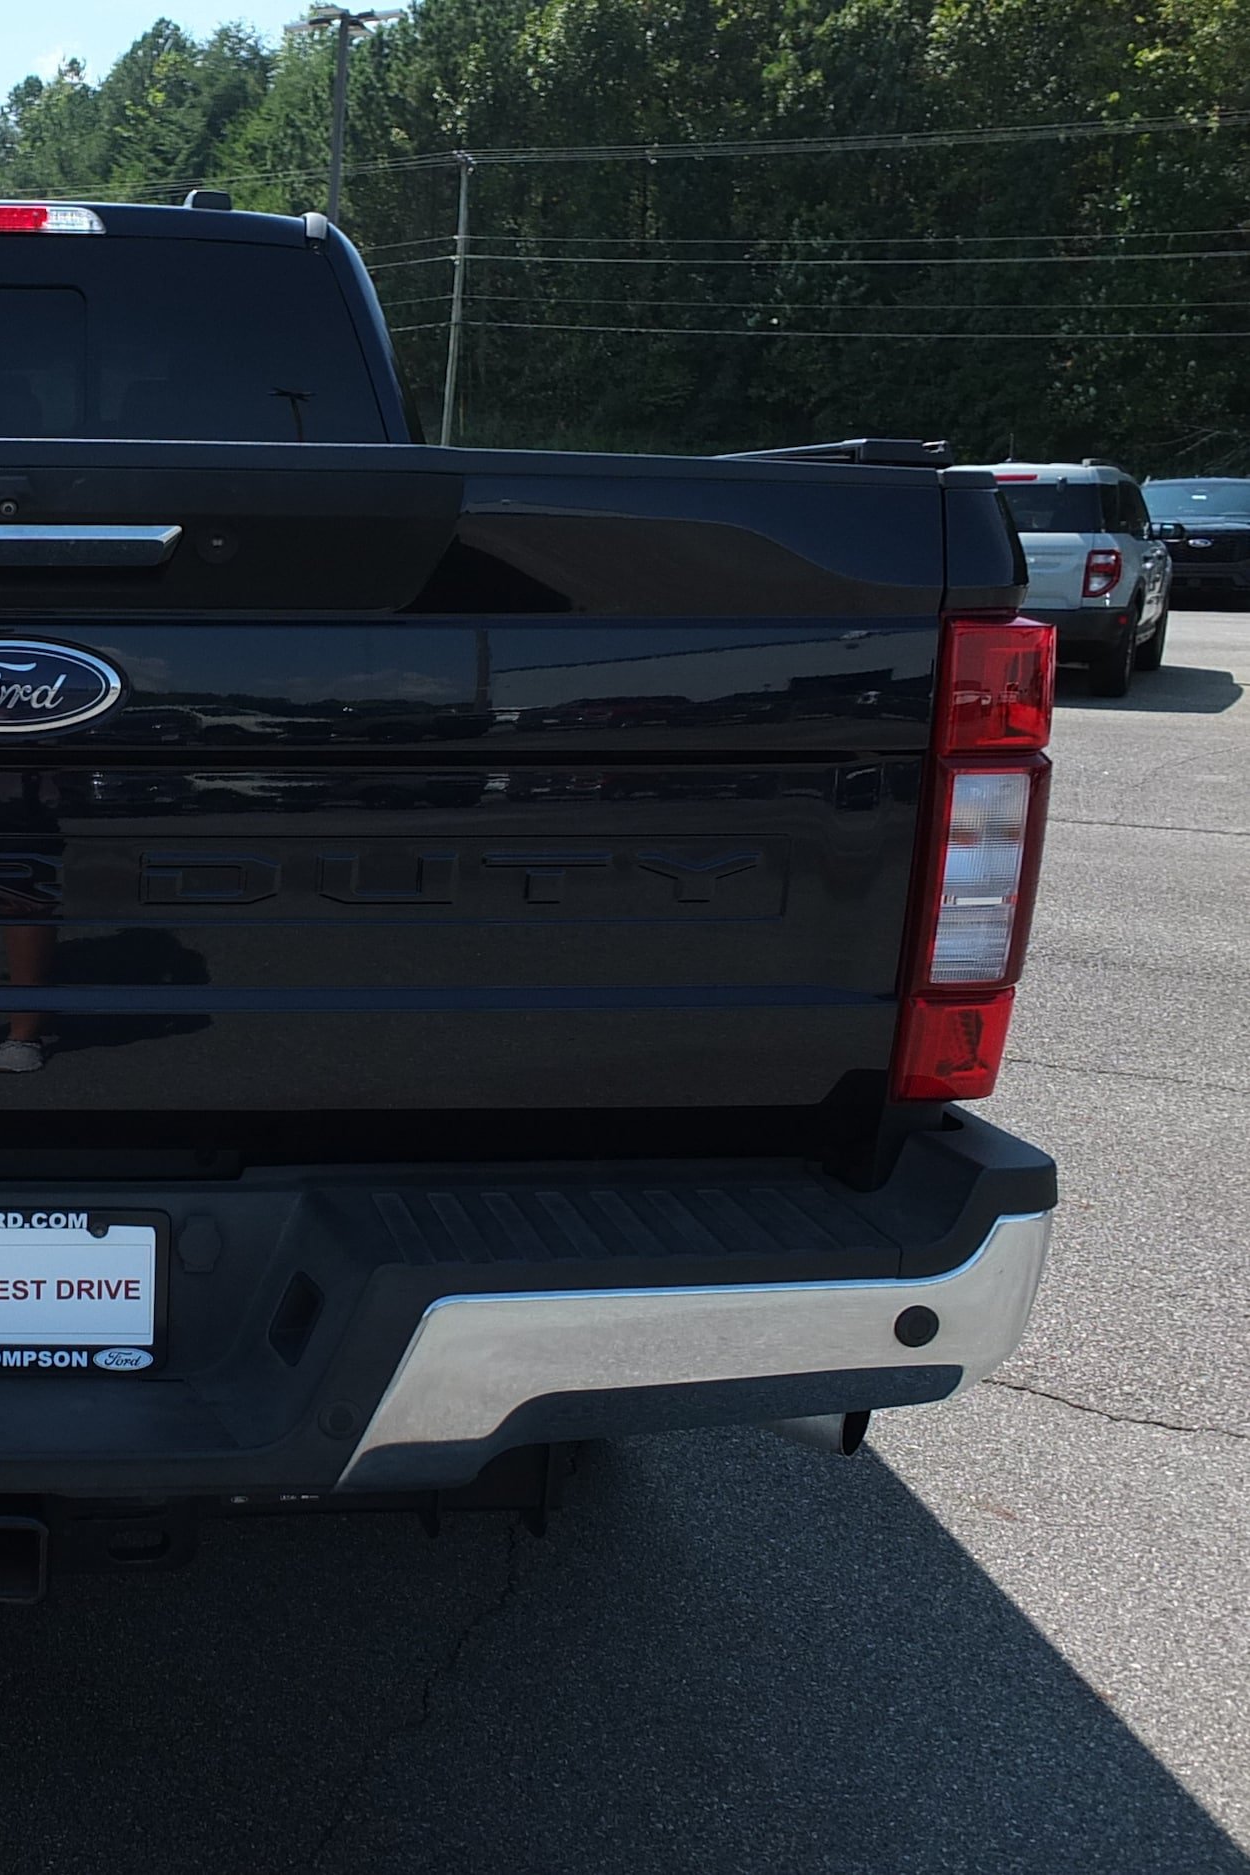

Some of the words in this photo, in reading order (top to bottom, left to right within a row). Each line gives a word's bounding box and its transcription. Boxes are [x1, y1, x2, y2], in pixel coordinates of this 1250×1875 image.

[140, 848, 765, 908] DUTY
[56, 1280, 141, 1300] DRIVE
[104, 1350, 142, 1367] Ford
